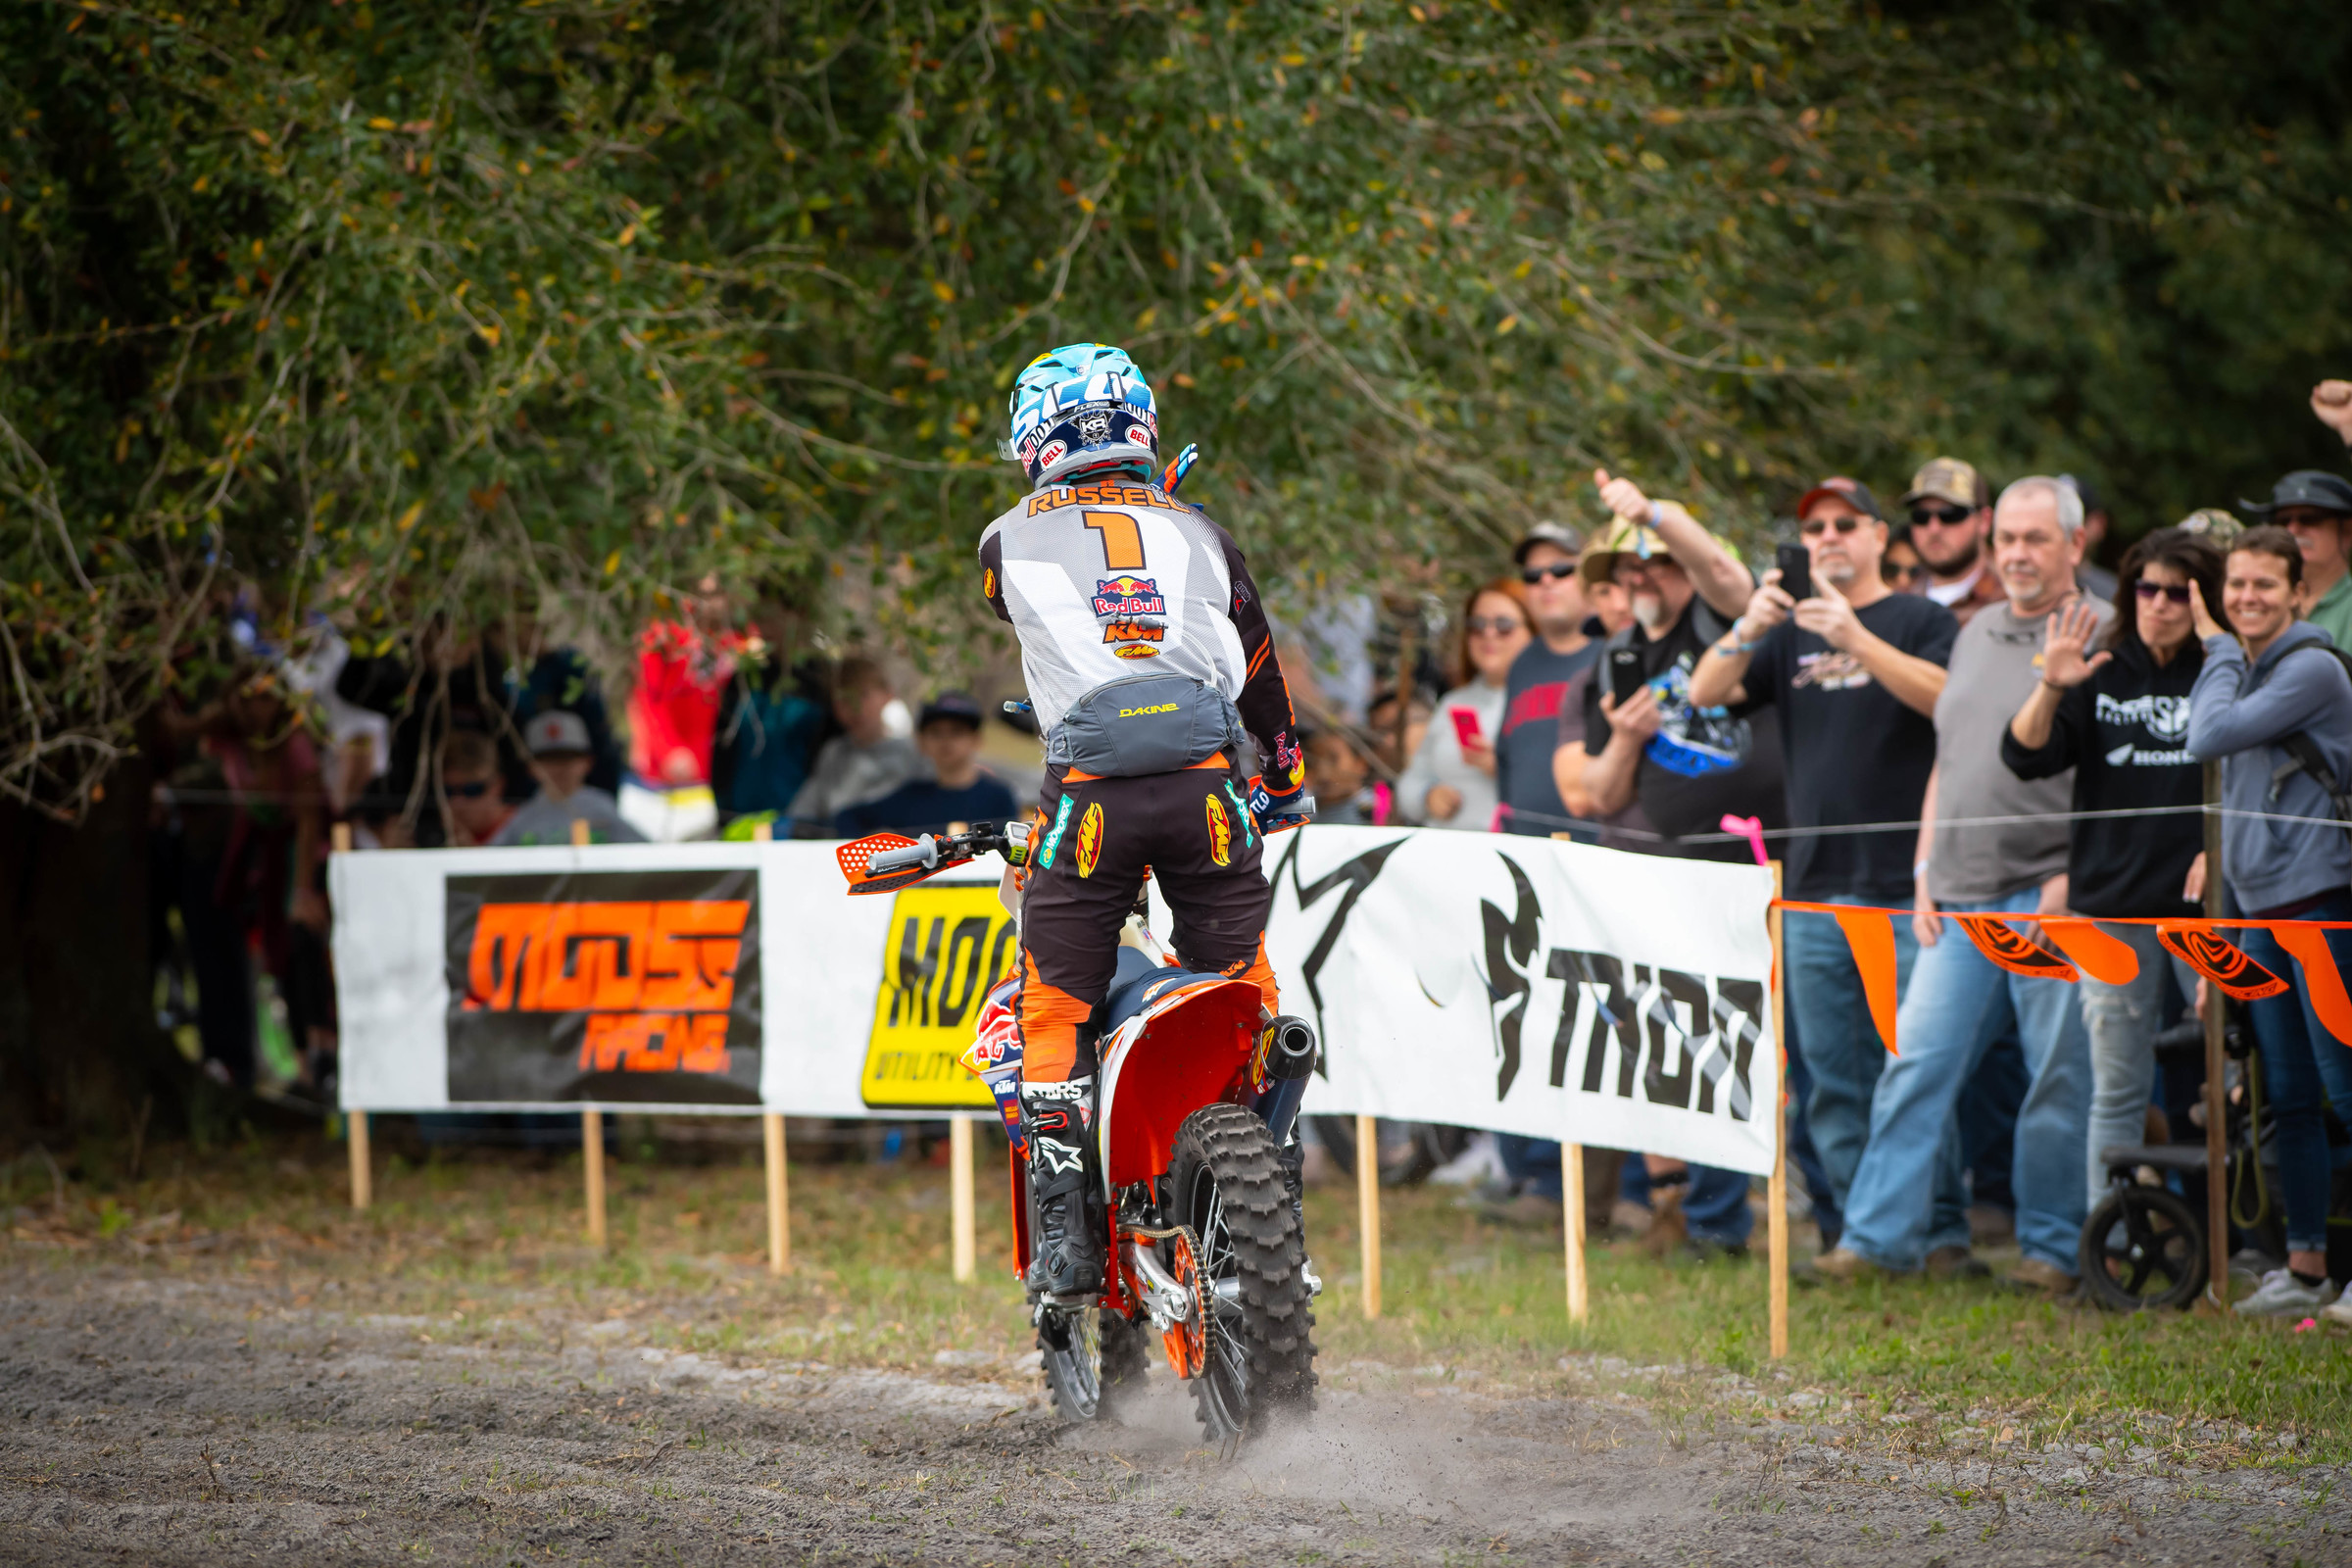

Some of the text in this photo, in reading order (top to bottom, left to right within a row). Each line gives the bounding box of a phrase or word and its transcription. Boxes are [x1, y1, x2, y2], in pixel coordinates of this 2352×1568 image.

[1041, 445, 1063, 466] BELL
[1129, 429, 1149, 447] BELL
[1026, 486, 1192, 518] RUSSELL
[1081, 511, 1147, 571] 1
[1095, 597, 1163, 614] Red Bull
[1118, 703, 1180, 718] DAKINE
[1046, 800, 1070, 850] MOTOREX
[1076, 802, 1103, 878] FMF
[1206, 794, 1231, 866] FMF
[462, 900, 751, 1012] MOOSE
[889, 915, 1017, 1027] MOO
[577, 1012, 731, 1074] RACING
[1544, 947, 1764, 1122] THOR
[995, 1079, 1016, 1095] KTM
